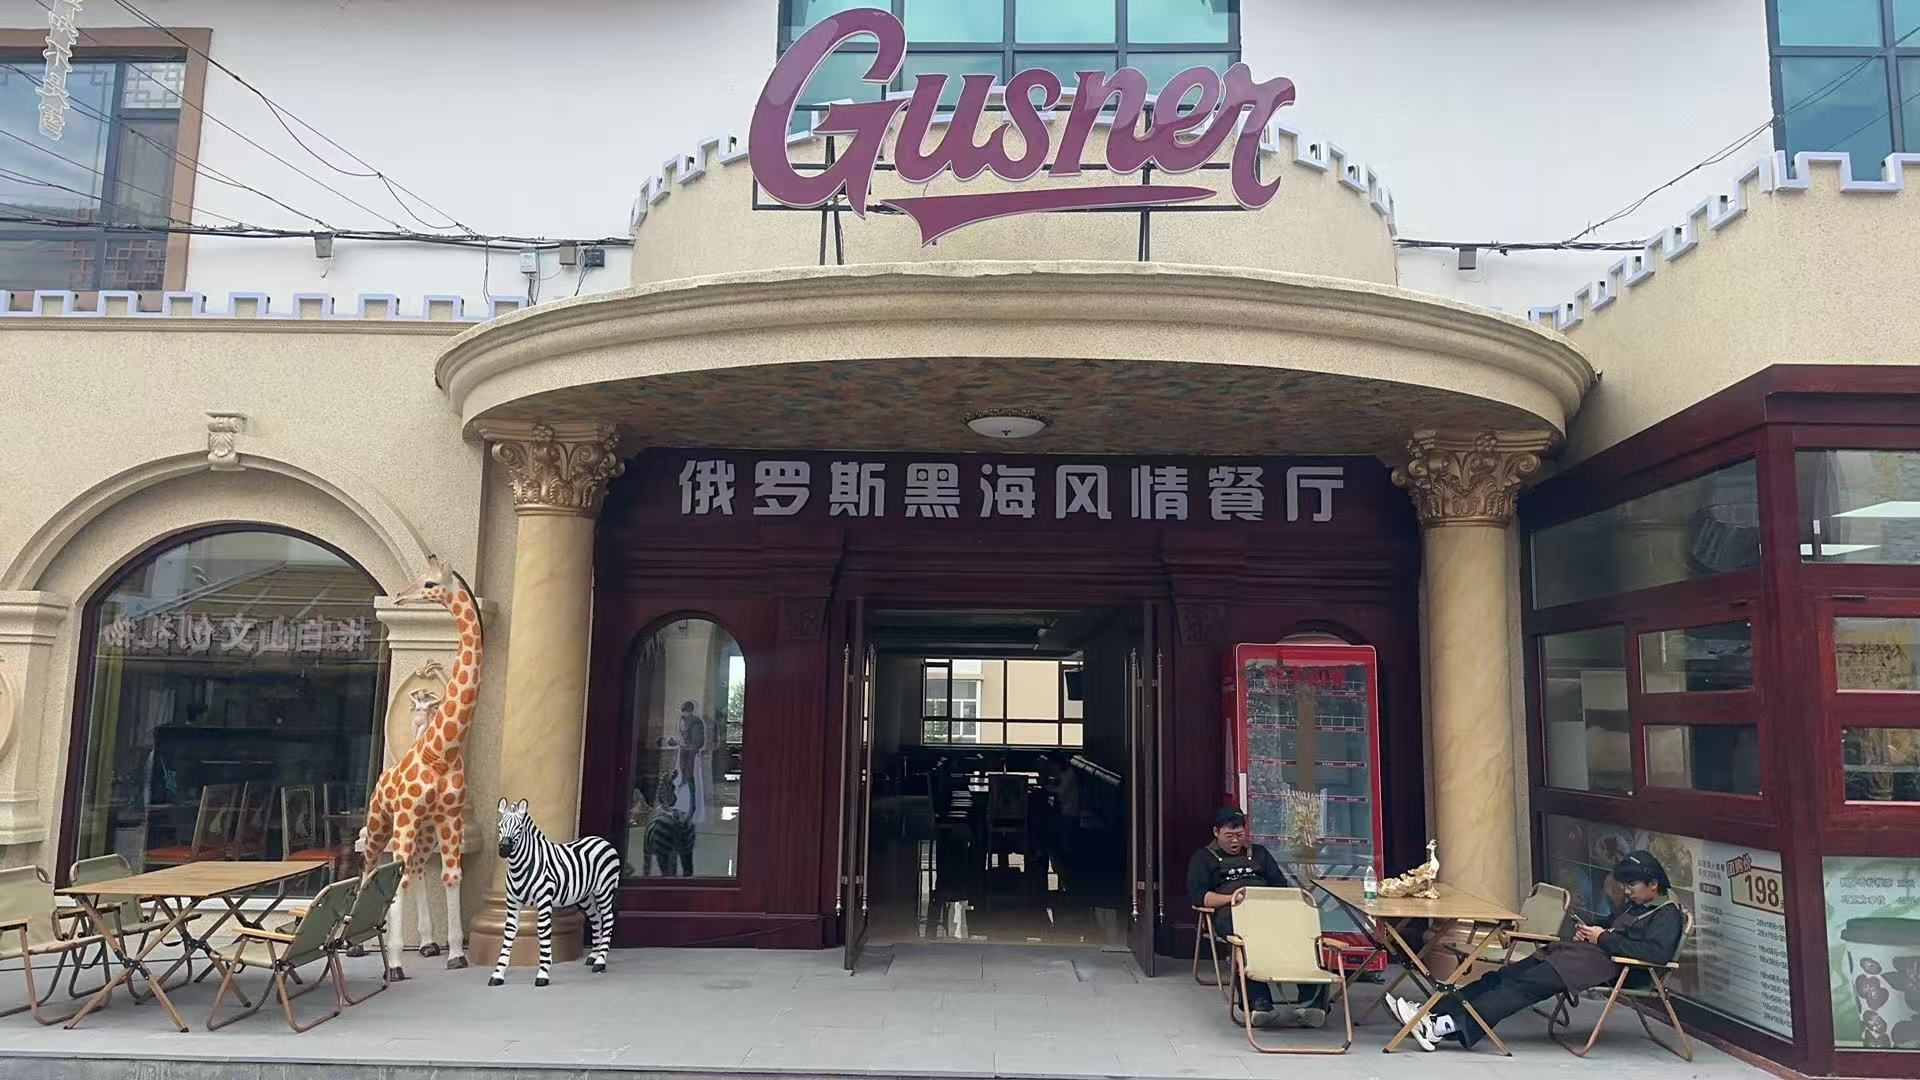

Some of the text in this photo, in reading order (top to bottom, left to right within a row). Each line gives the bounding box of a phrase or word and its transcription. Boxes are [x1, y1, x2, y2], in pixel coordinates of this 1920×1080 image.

[748, 7, 1296, 219] Gusner
[678, 458, 1345, 523] 俄罗斯黑海风情餐厅
[1744, 874, 1780, 908] 198
